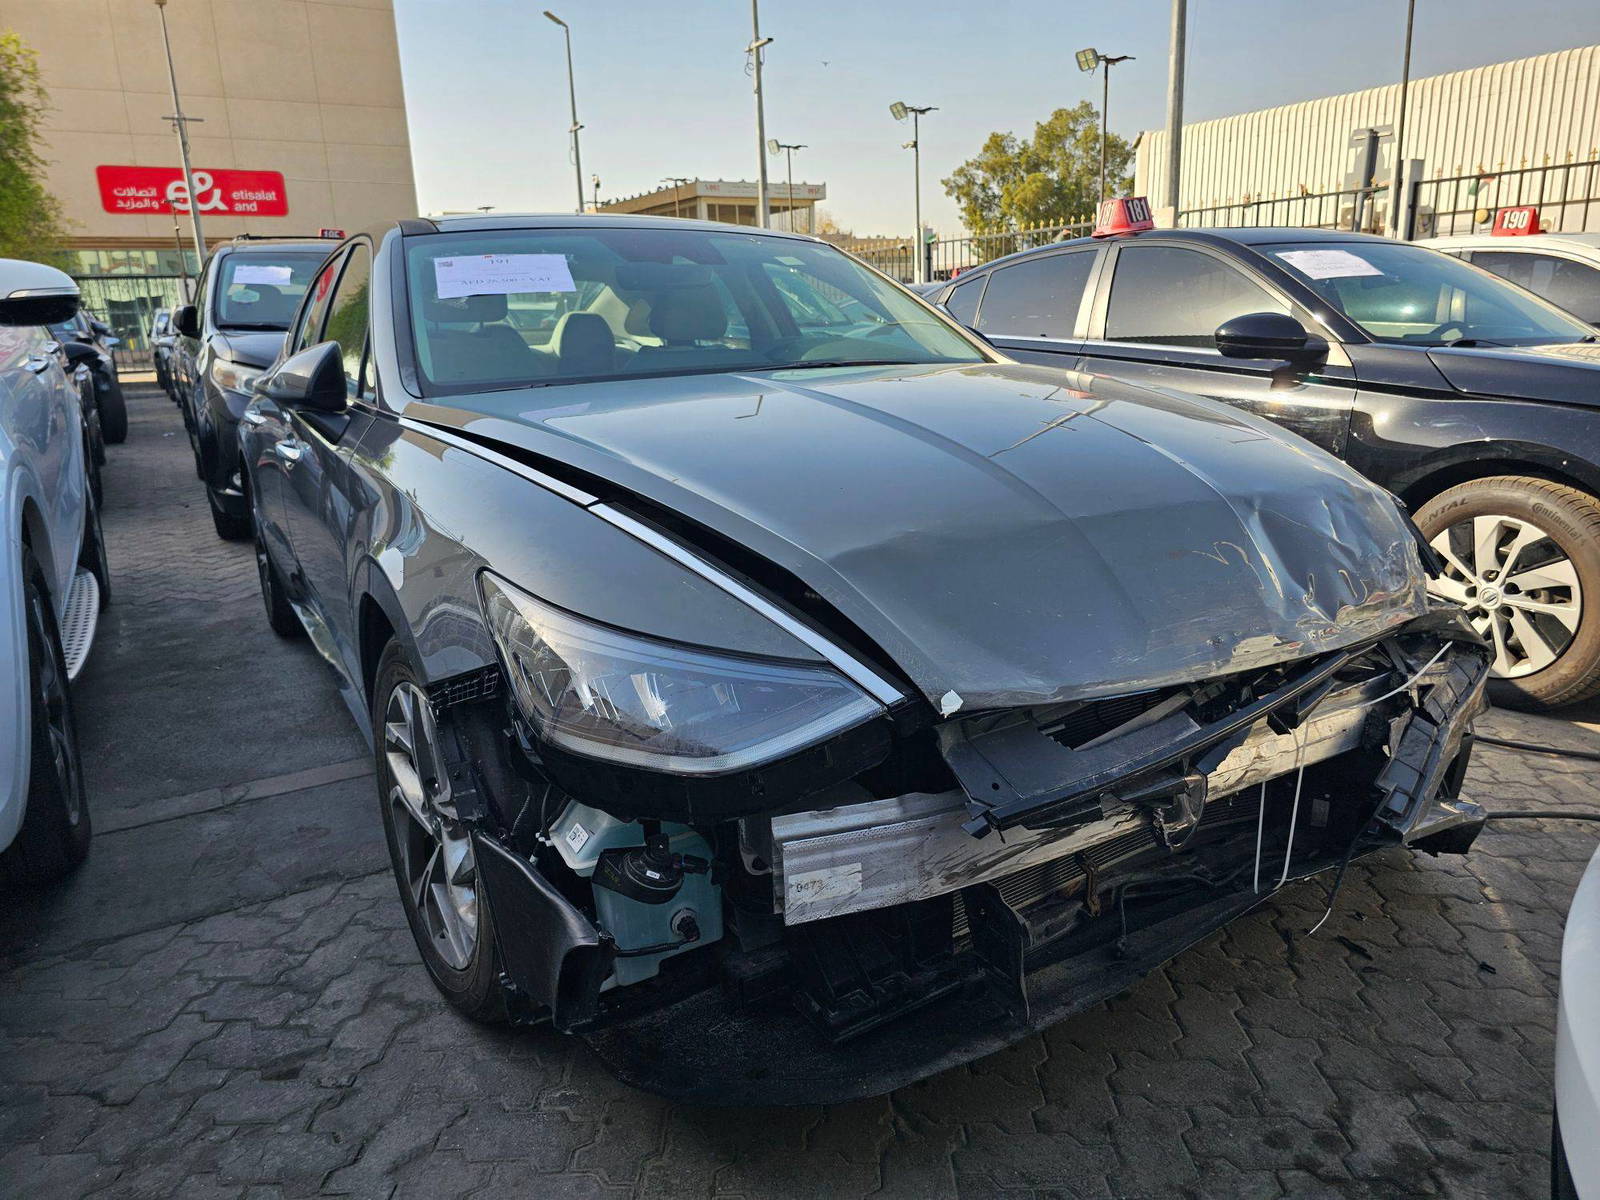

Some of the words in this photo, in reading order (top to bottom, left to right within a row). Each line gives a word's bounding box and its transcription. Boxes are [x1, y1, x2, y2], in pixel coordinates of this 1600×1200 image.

[113, 187, 157, 197] اتصالات
[166, 171, 229, 211] e&
[231, 191, 277, 201] etisalat
[116, 198, 159, 210] والمزيد
[234, 201, 258, 212] and
[1127, 198, 1149, 222] 181
[1502, 210, 1529, 229] 190
[1531, 502, 1583, 542] Continental
